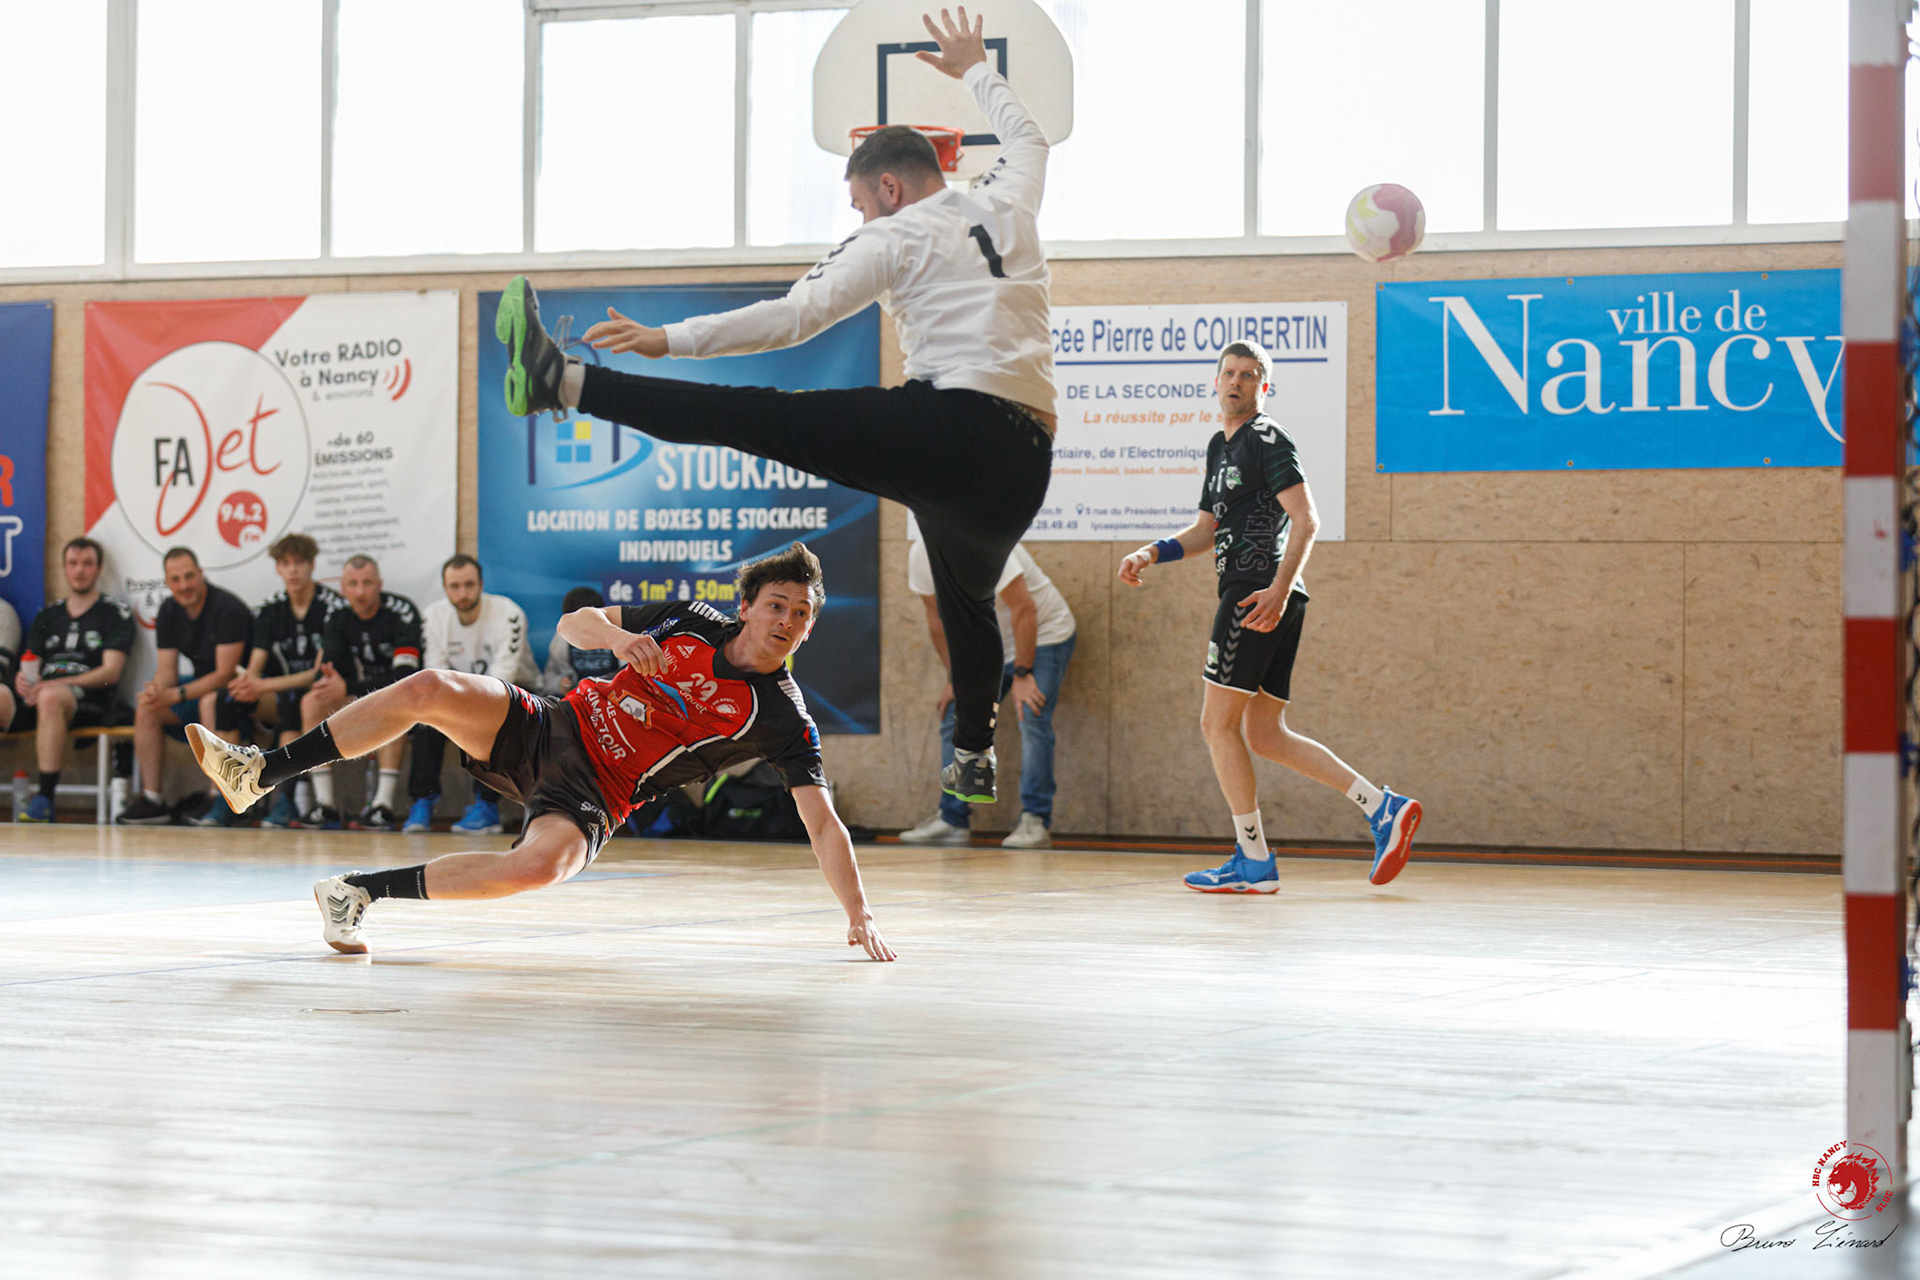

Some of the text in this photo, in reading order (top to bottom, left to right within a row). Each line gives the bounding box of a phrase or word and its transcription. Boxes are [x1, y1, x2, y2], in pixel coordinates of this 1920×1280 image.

[968, 224, 1011, 278] 1
[1606, 289, 1768, 335] ville de
[1092, 319, 1153, 352] Pierre
[1161, 318, 1186, 351] de
[1194, 316, 1327, 350] COUBERTIN
[275, 339, 402, 367] Votre RADIO
[300, 369, 379, 387] à Nancy
[1428, 293, 1846, 443] Nancy
[1067, 384, 1089, 399] DE
[1096, 384, 1116, 398] LA
[1123, 383, 1206, 398] SECONDE
[1083, 411, 1101, 424] La
[1105, 410, 1166, 424] réussite
[1169, 412, 1195, 426] par
[1198, 411, 1213, 423] le
[1100, 446, 1115, 458] de
[221, 502, 263, 523] 94.2
[527, 507, 828, 531] LOCATION DE BOXES DE STOCKAGE
[619, 540, 733, 563] INDIVIDUELS
[609, 580, 632, 601] de
[678, 580, 690, 601] à
